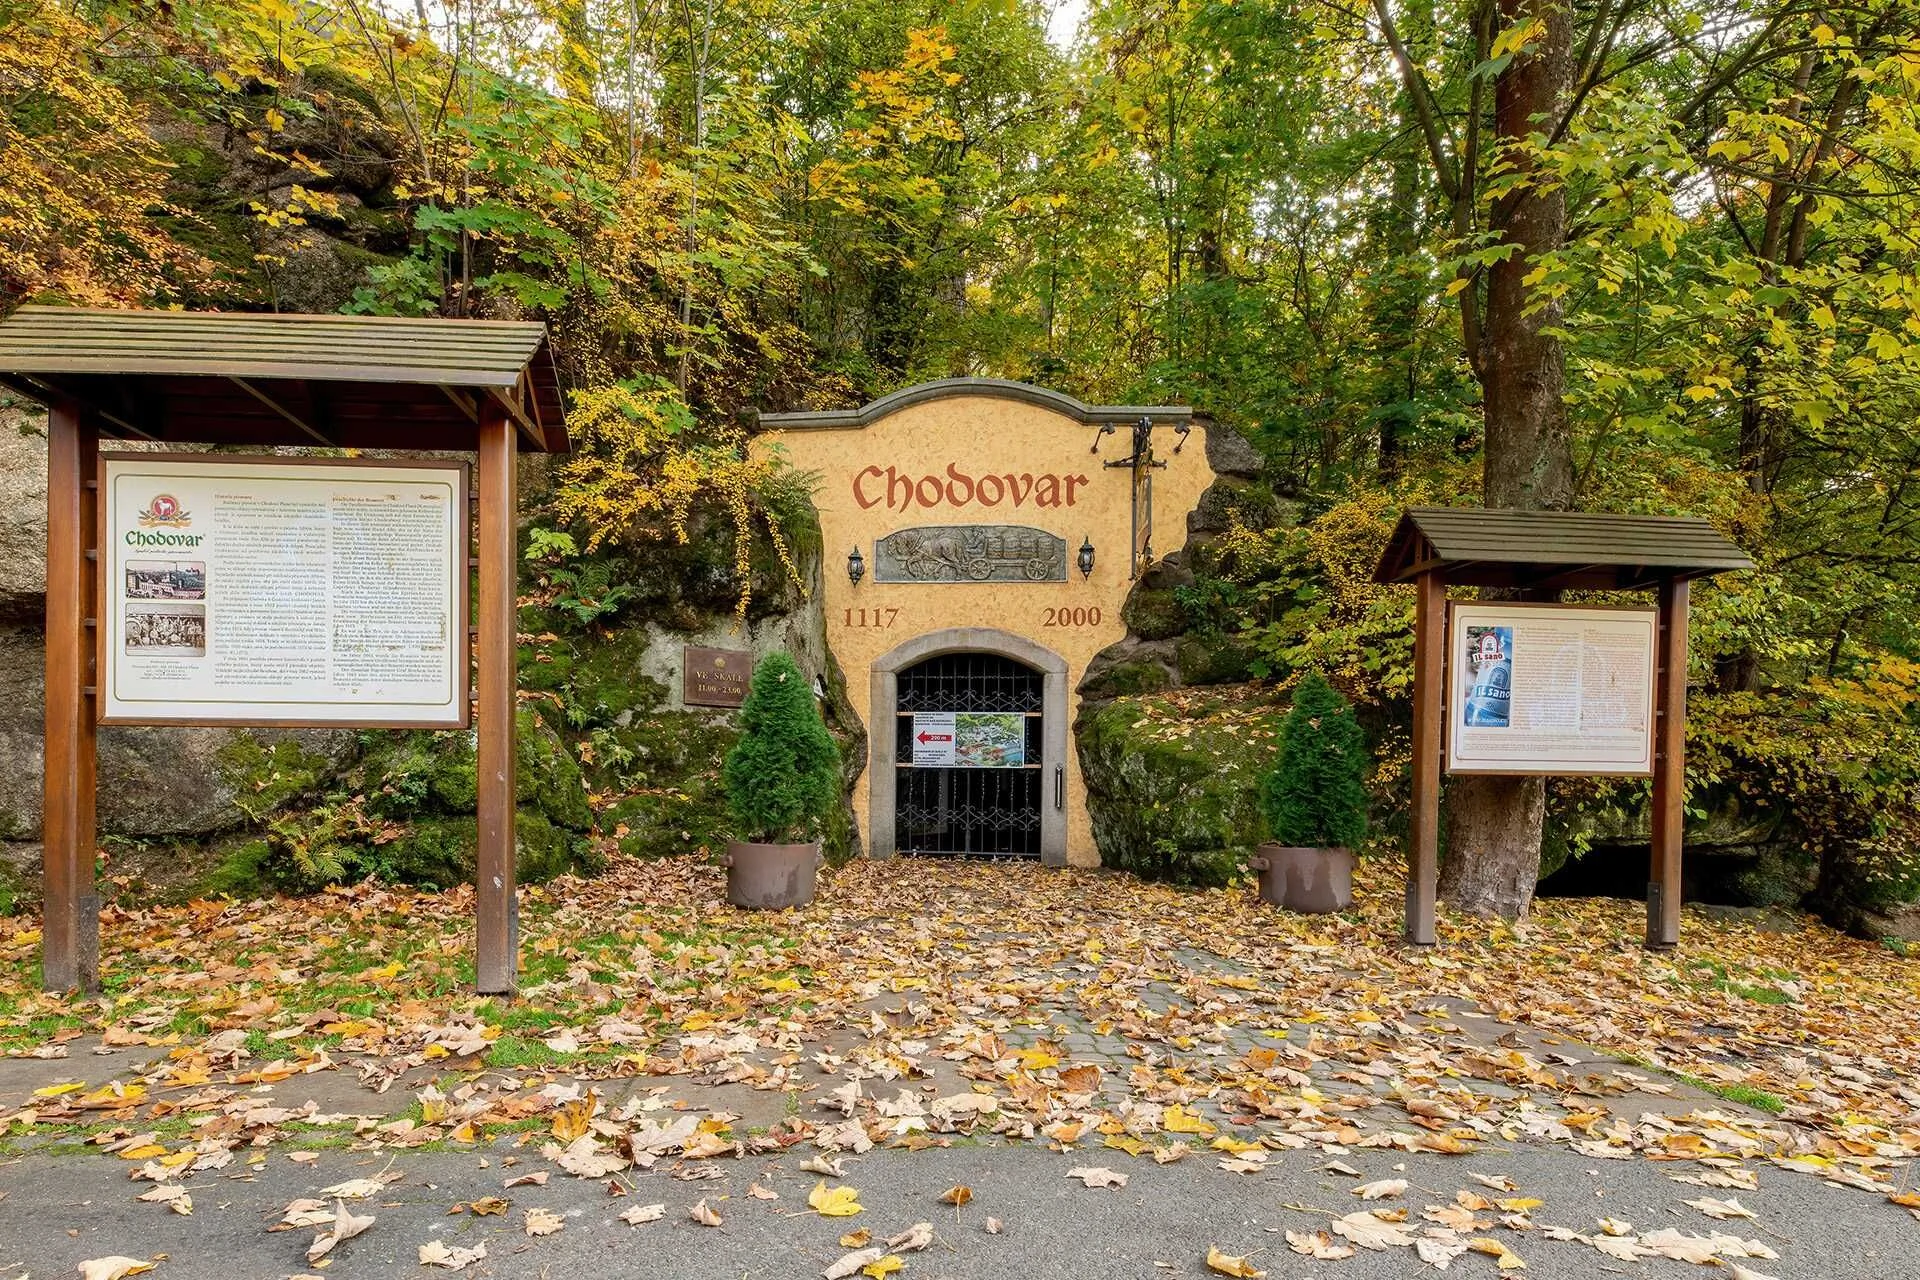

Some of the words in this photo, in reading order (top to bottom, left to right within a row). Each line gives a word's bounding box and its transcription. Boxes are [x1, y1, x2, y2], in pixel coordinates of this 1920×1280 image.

[852, 462, 1090, 514] Chodovar
[125, 530, 204, 547] Chodovar
[843, 606, 900, 629] 1117
[1042, 605, 1102, 627] 2000
[696, 671, 709, 680] VE
